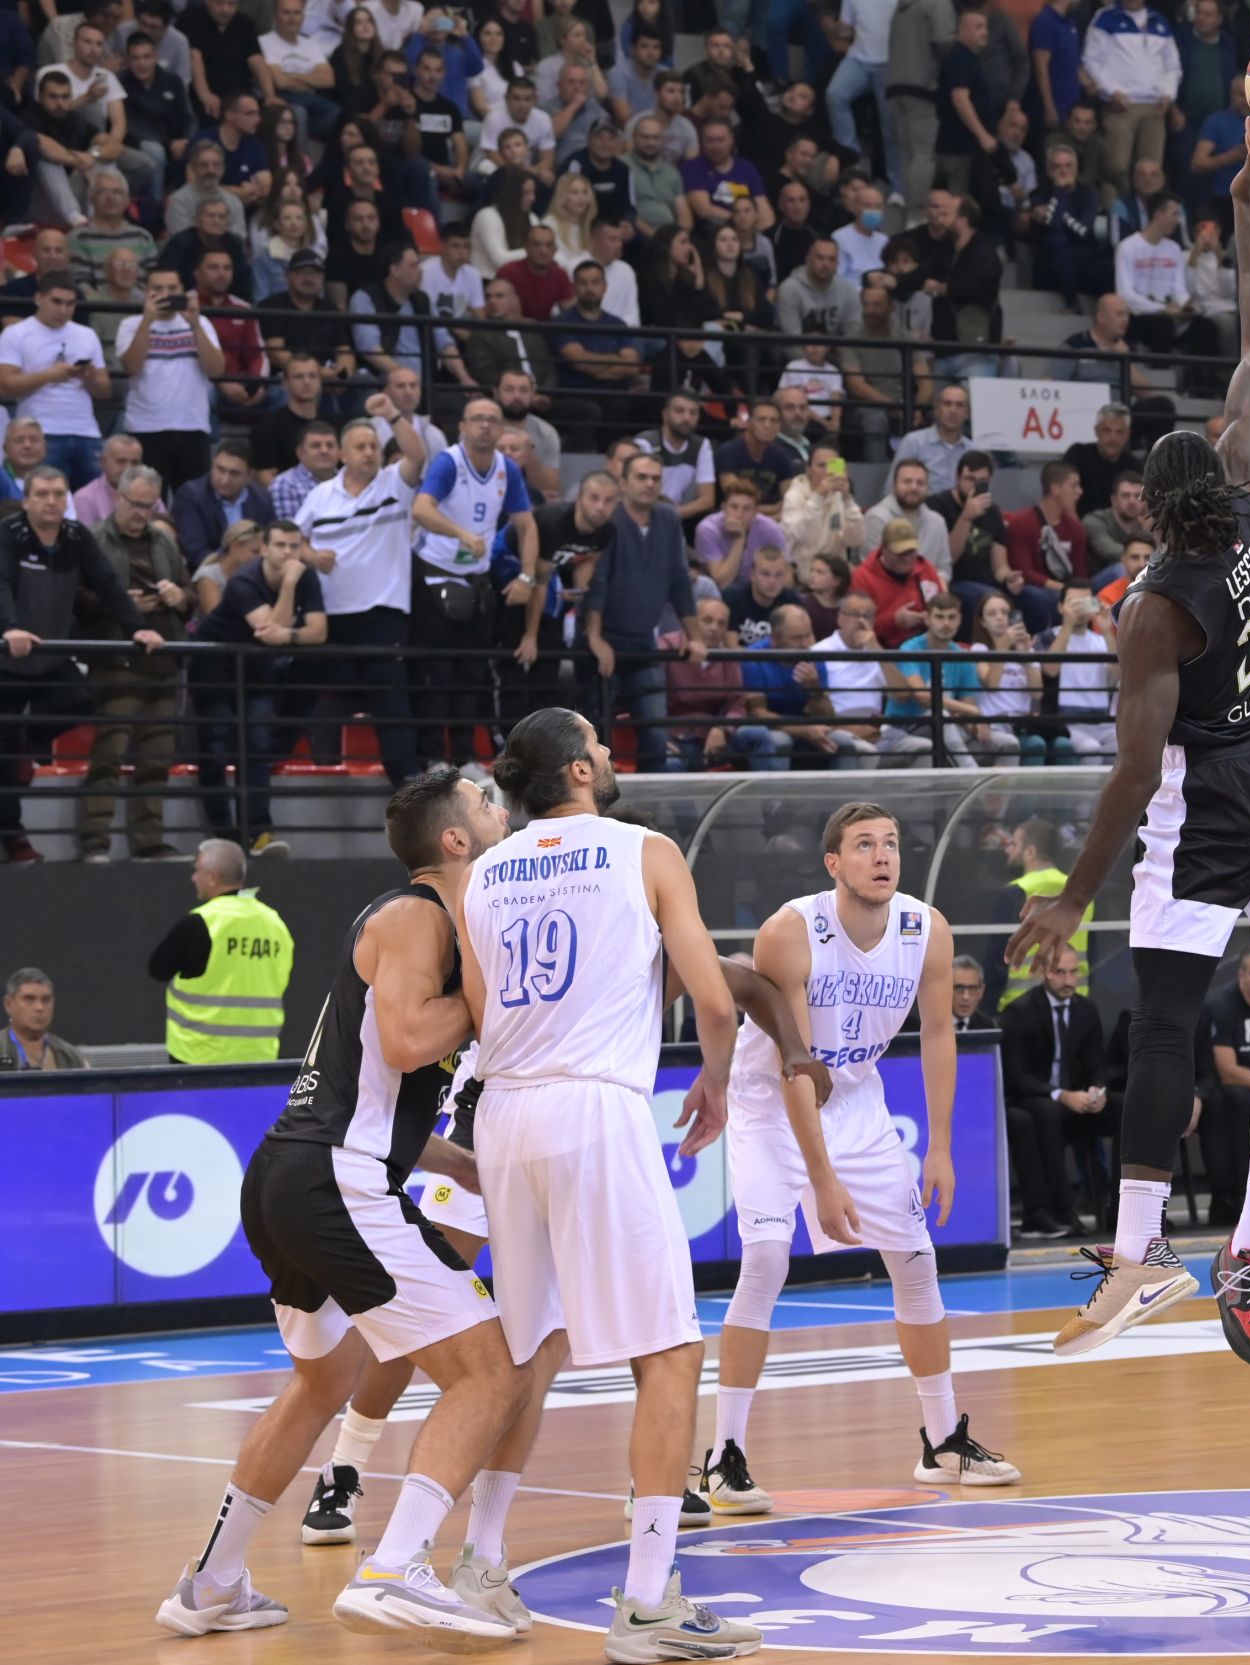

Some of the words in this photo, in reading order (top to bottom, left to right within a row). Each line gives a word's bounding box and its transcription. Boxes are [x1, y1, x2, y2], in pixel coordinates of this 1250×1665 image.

[473, 502, 487, 523] 9
[483, 846, 590, 891] STOJANOVSKI
[594, 846, 612, 870] D.
[549, 883, 601, 898] SISTINA
[227, 936, 281, 960] РЕДАР
[500, 908, 578, 1009] 19
[808, 970, 845, 1008] MZT
[842, 972, 914, 1009] SKOPJE
[841, 1009, 863, 1041] 4
